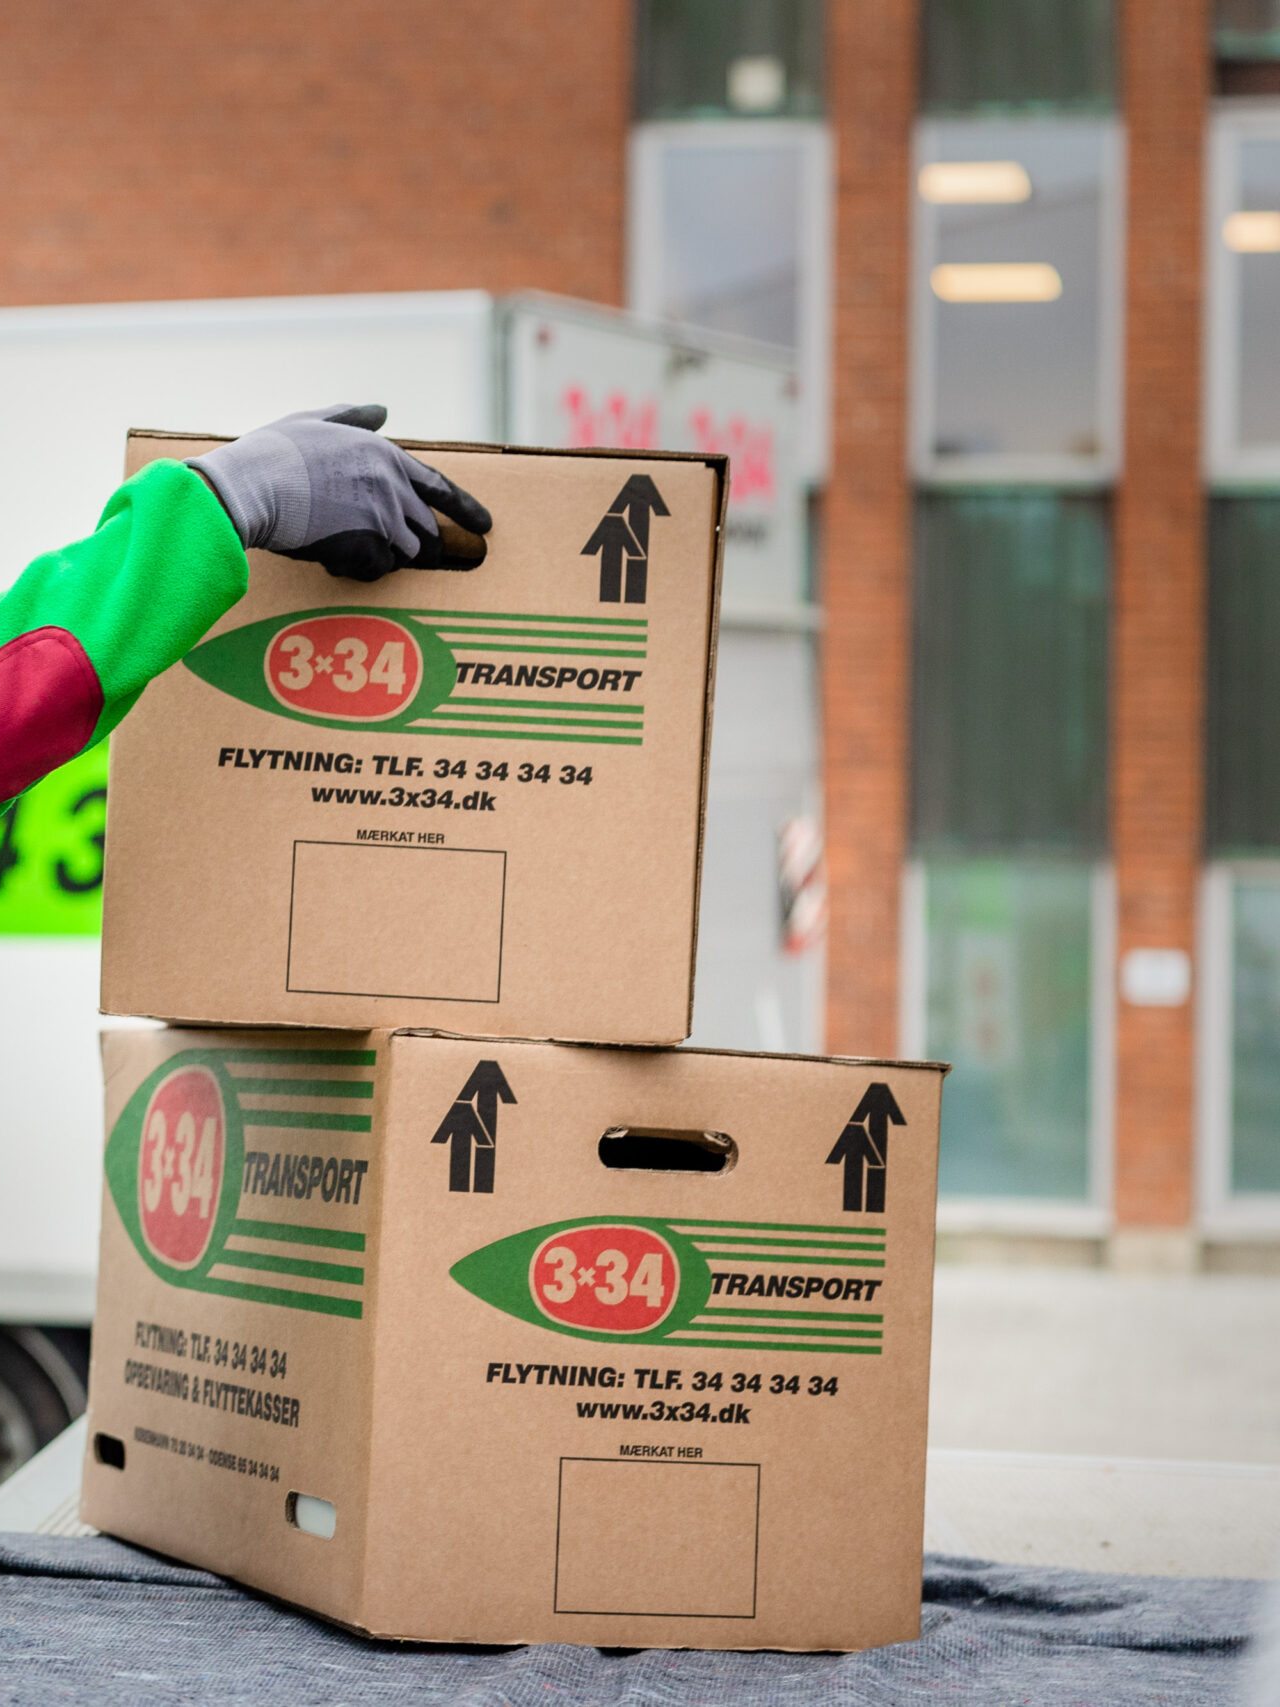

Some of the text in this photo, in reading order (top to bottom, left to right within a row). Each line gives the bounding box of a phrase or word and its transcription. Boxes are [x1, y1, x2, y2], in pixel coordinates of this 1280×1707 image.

[455, 662, 643, 692] TRANSPORT
[218, 747, 593, 786] FLYTNING: TLF. 34 34 34 34
[311, 786, 497, 811] www.3x34.dk
[356, 828, 445, 844] MÆRKAT HER
[244, 1151, 369, 1205] TRANSPORT
[711, 1272, 883, 1302] TRANSPORT
[135, 1320, 287, 1379] FLYTNING: TLF. 34 34 34 34
[486, 1362, 838, 1396] FLYTNING: TLF. 34 34 34 34
[203, 1378, 300, 1428] FLYTTEKASSER
[576, 1400, 752, 1424] www.3x34.dk
[619, 1444, 703, 1458] MÆRKAT HER
